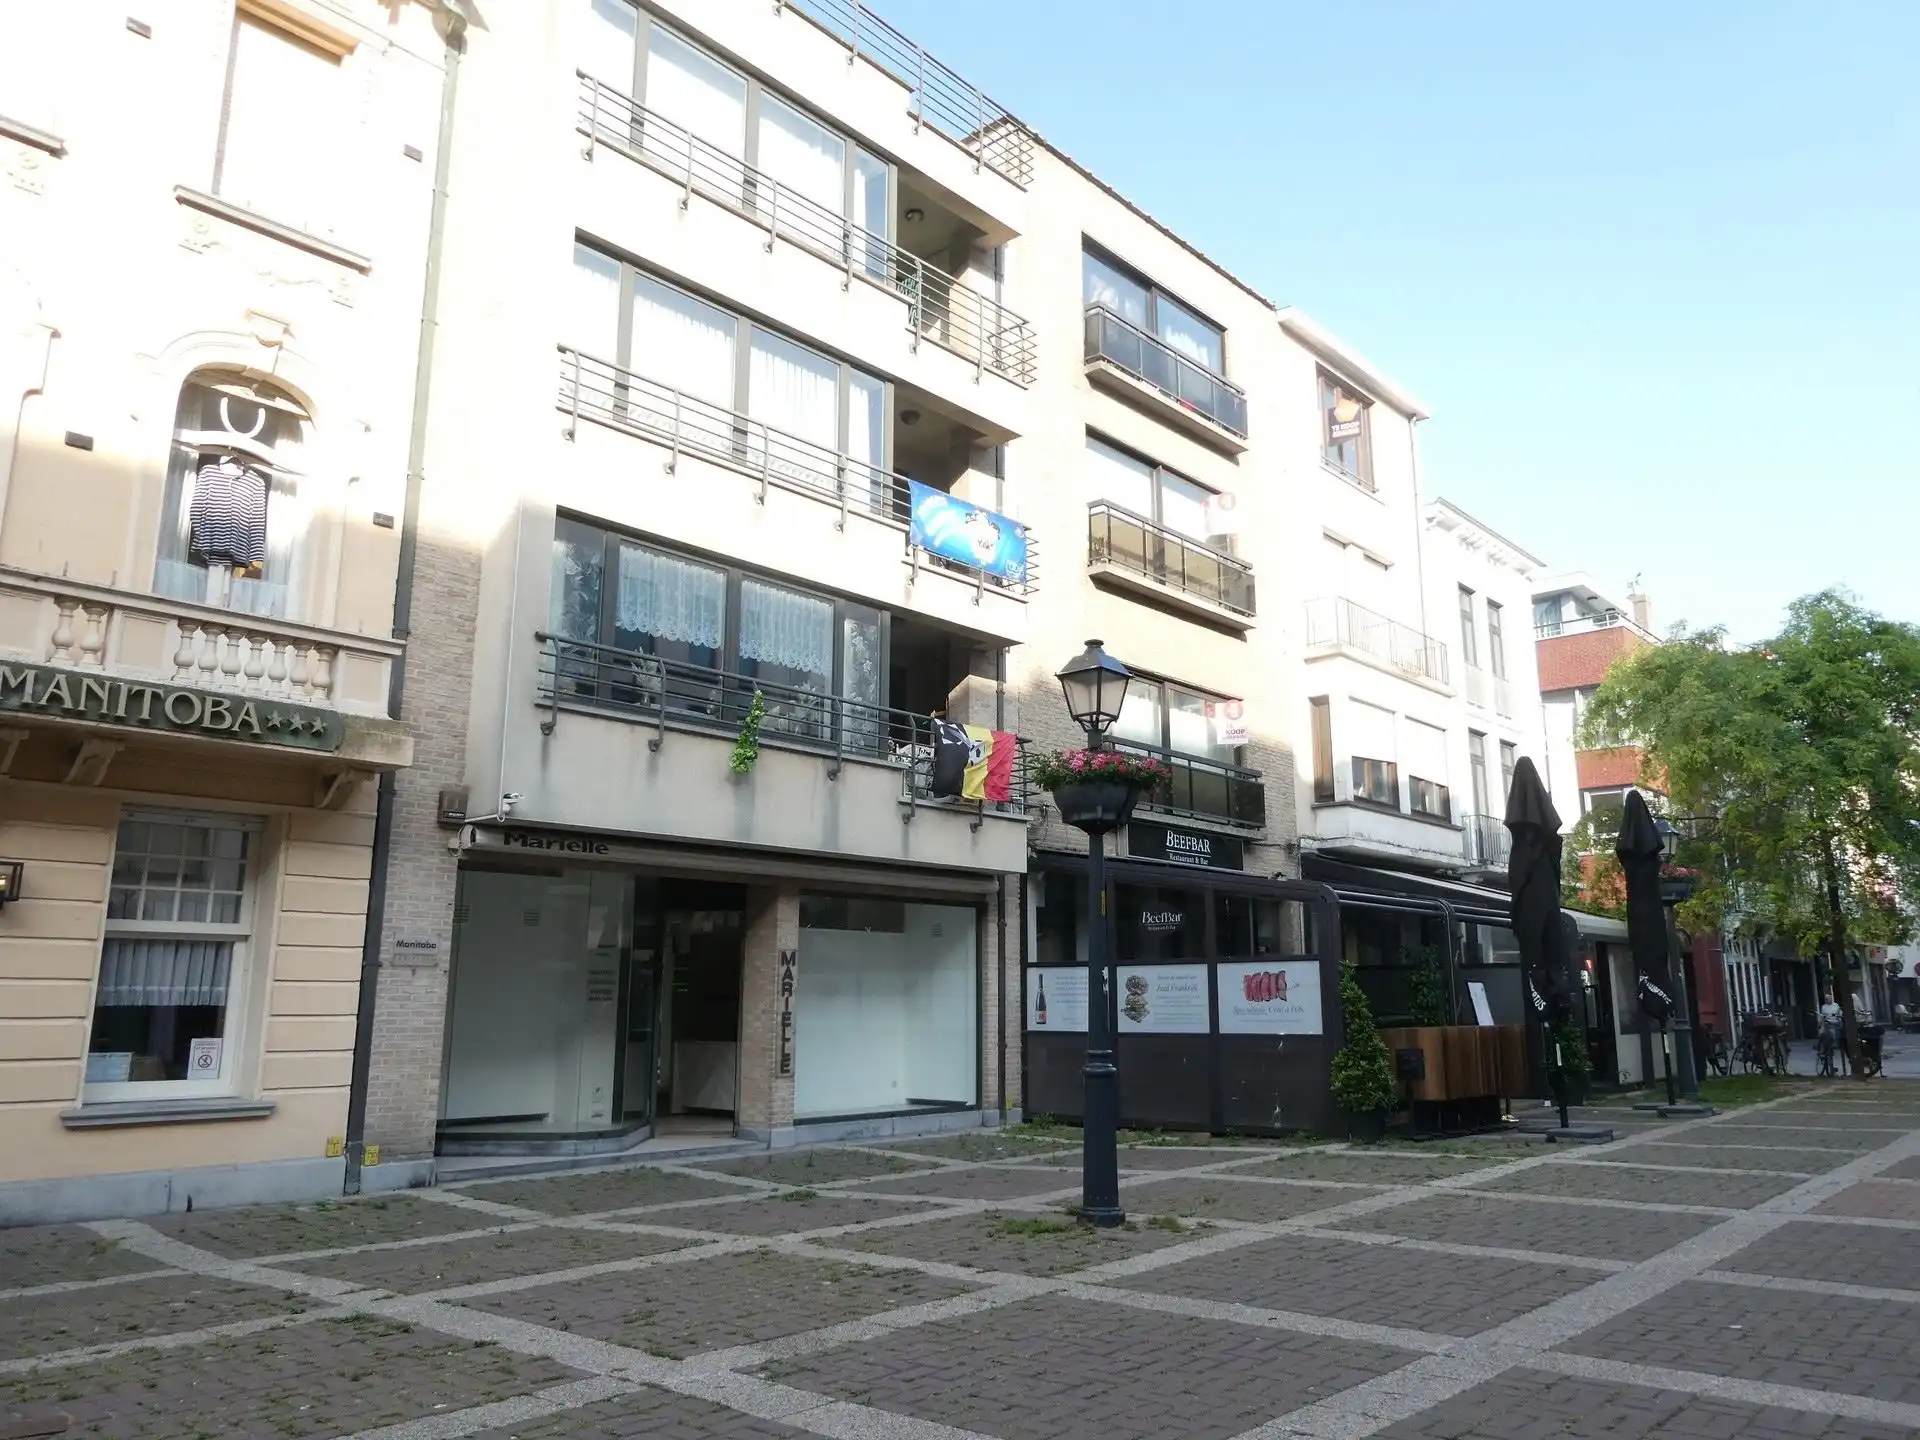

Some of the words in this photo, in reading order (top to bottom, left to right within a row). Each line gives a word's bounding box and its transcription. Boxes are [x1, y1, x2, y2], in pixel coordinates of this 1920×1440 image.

[0, 665, 263, 736] MANITOBA
[503, 831, 610, 855] Marielle
[1166, 829, 1211, 853] BEEFBAR
[396, 939, 437, 949] Manitoba
[780, 951, 797, 1074] MARIELLE
